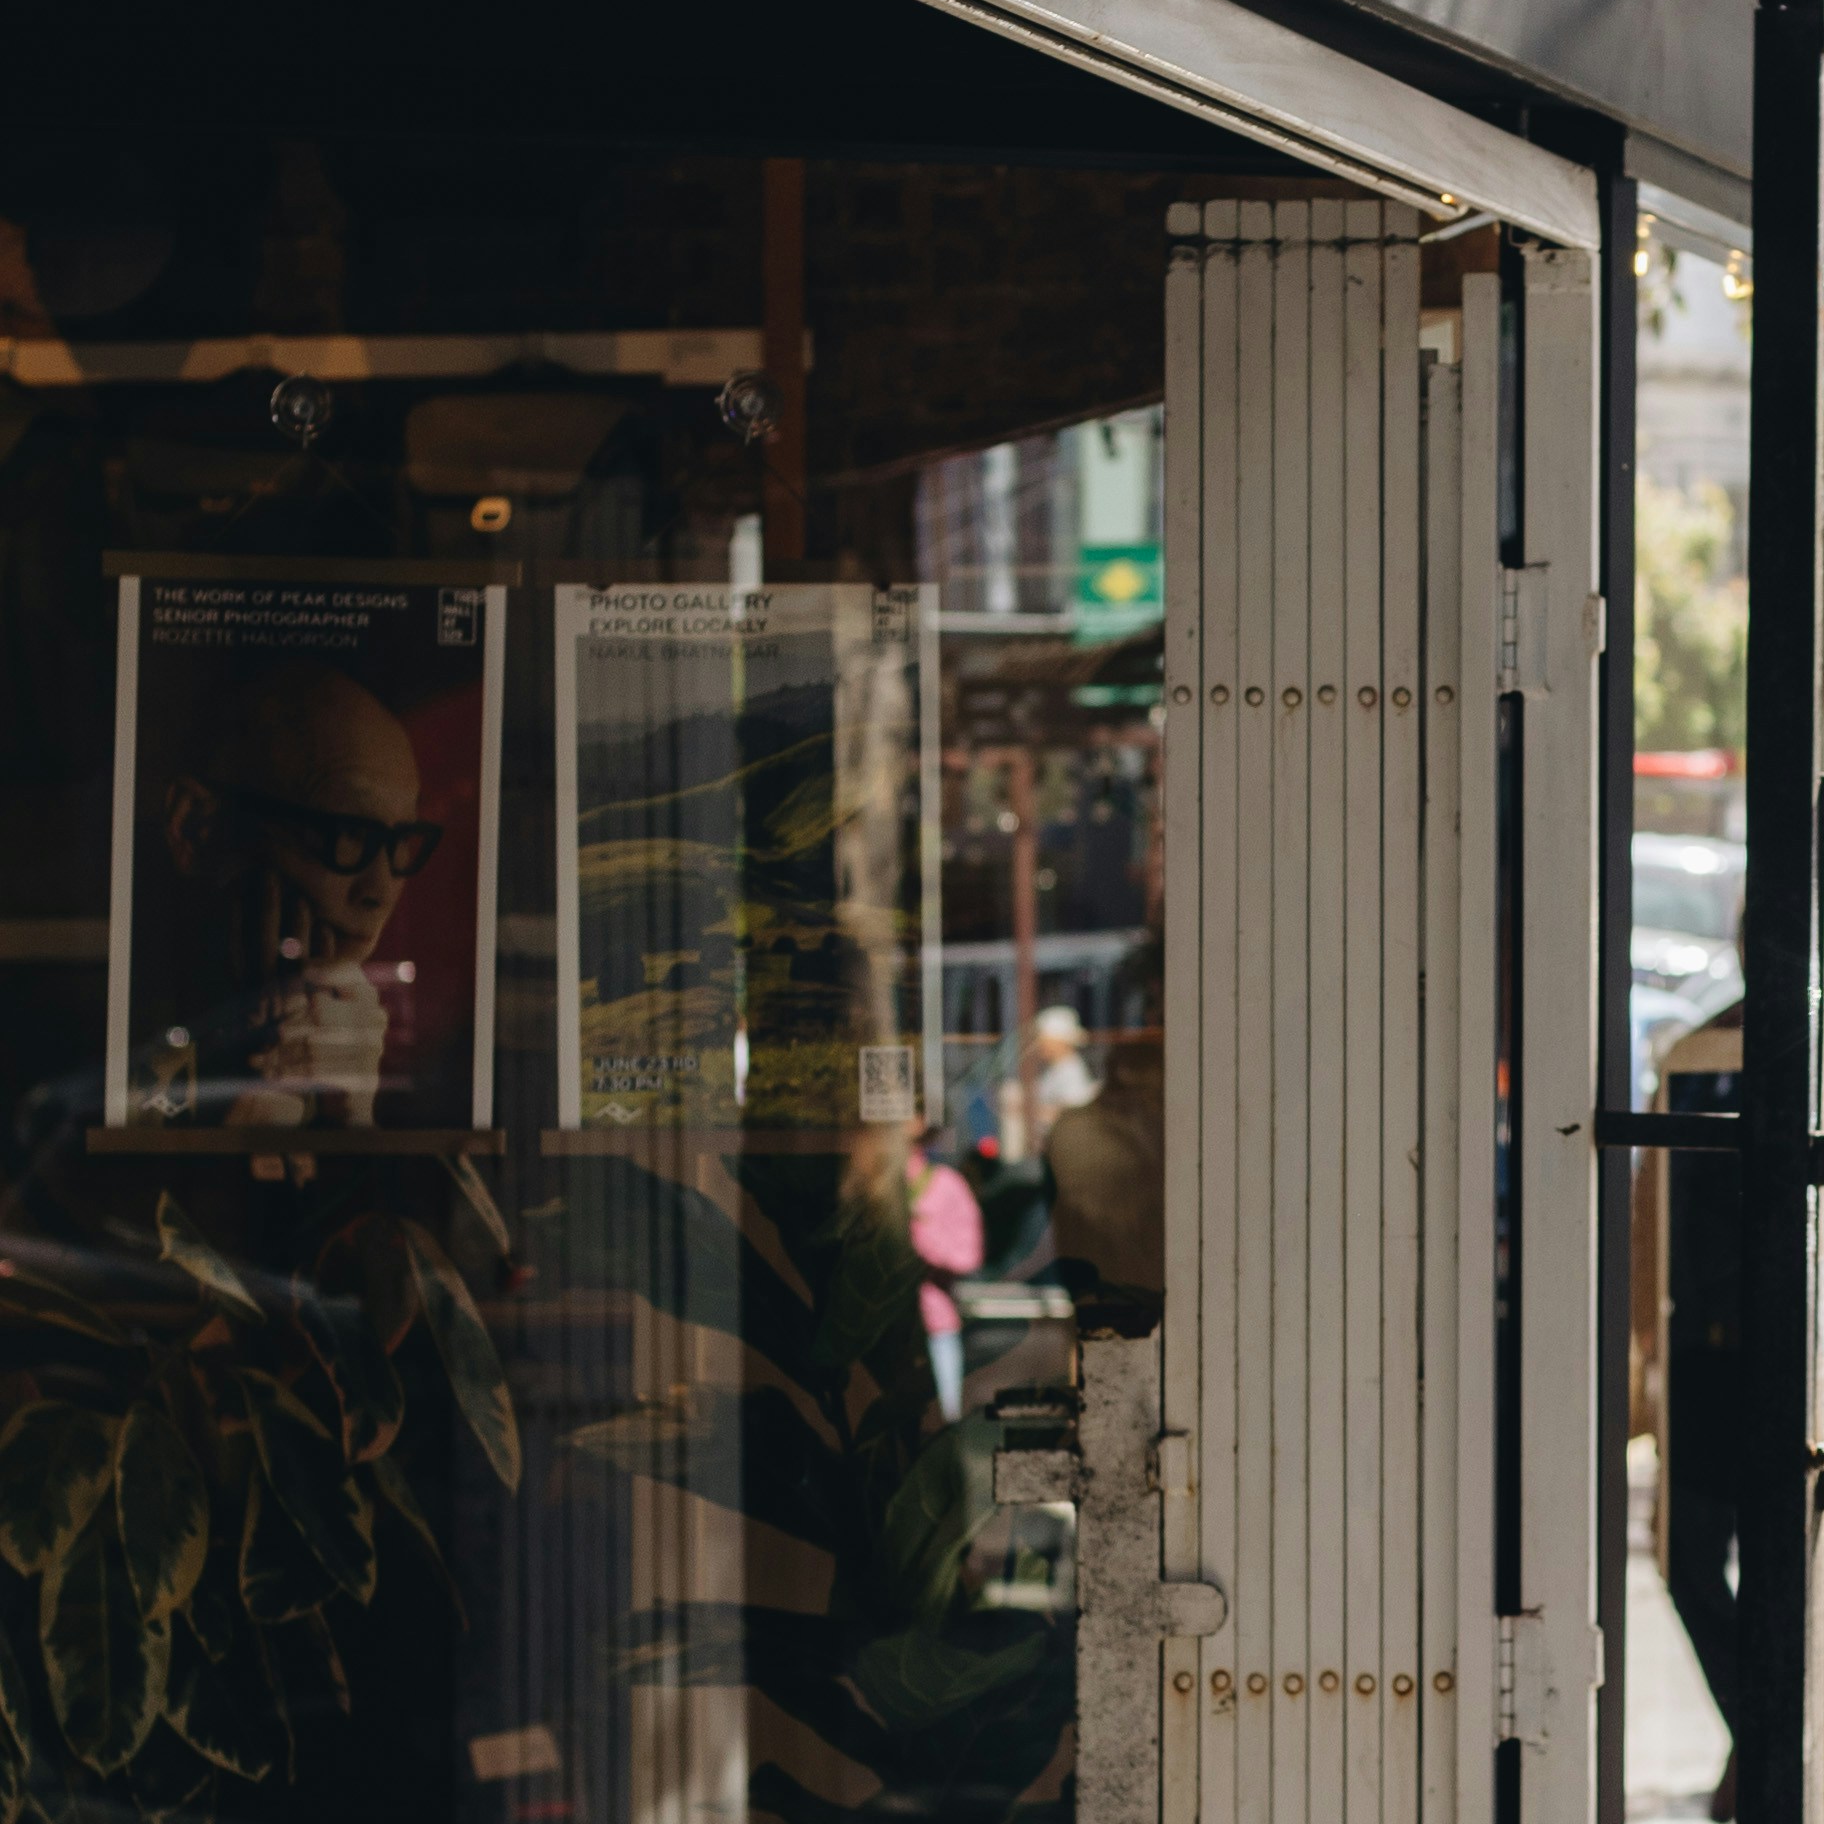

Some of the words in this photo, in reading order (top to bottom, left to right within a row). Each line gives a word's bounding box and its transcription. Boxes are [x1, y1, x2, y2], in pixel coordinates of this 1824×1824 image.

[154, 587, 187, 603] THE
[193, 588, 246, 605] WORK
[252, 590, 275, 605] OF
[281, 591, 326, 607] PEAK
[332, 592, 409, 610] DESIGNS
[590, 593, 666, 611] PHOTO
[673, 593, 773, 611] GALLRY
[153, 607, 218, 624] SENIOR
[224, 609, 371, 628] PHOTOGRAPHER
[590, 617, 677, 634] EXPLORE
